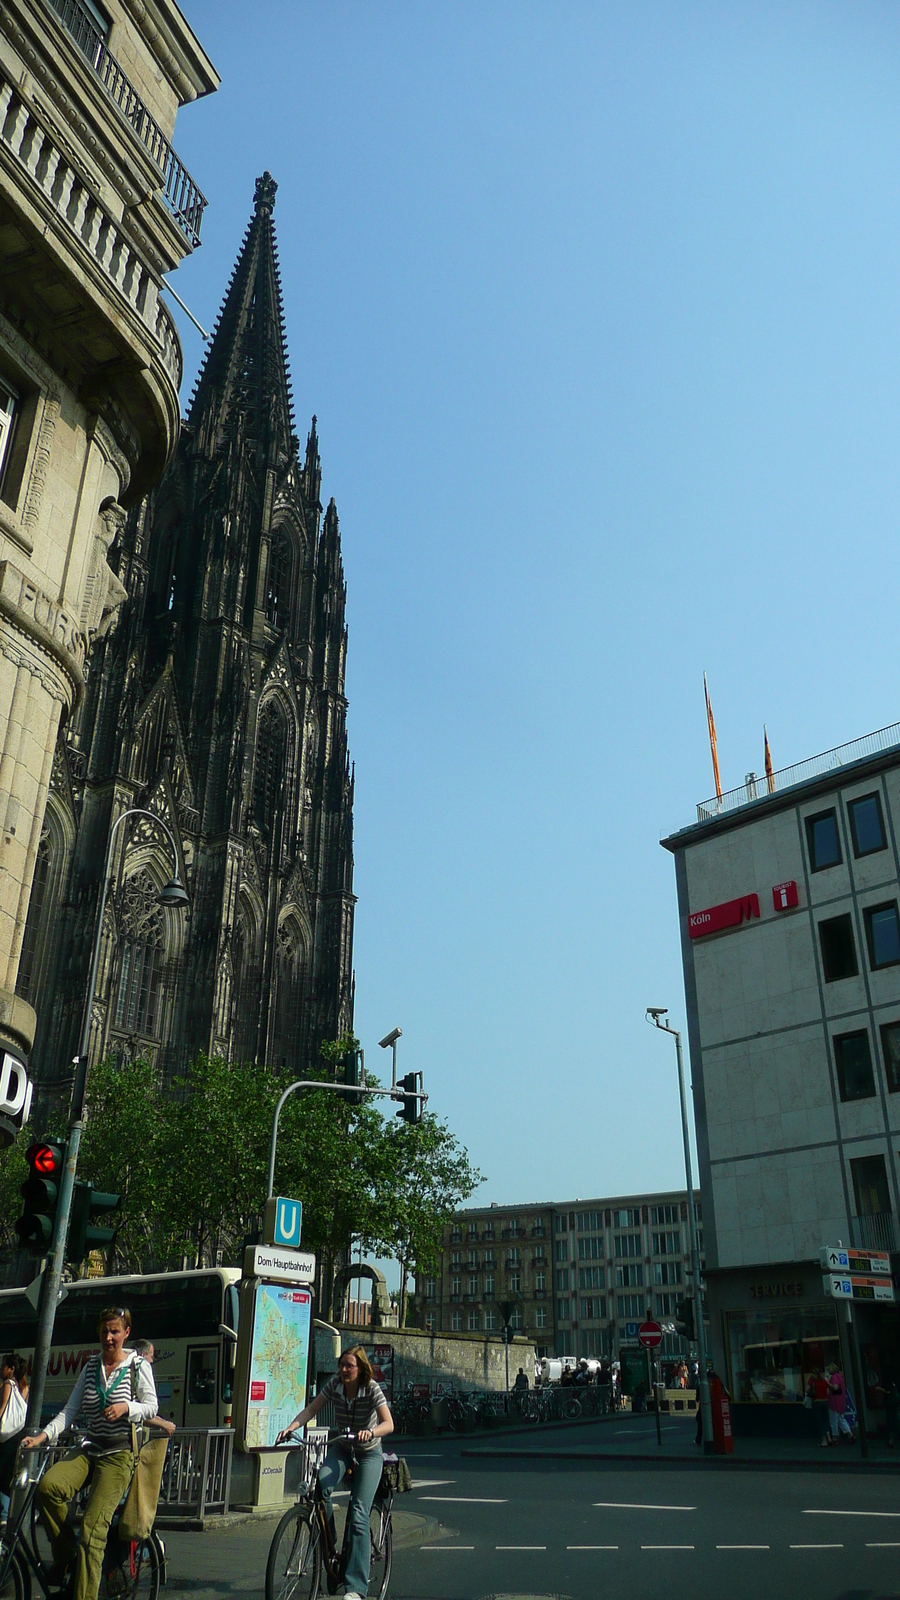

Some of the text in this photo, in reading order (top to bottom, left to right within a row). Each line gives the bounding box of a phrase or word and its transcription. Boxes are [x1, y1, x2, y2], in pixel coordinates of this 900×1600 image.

[773, 882, 792, 892] TOURIST
[690, 913, 711, 927] Köln
[279, 1203, 296, 1240] U
[257, 1255, 313, 1273] Dom/Hauptbahnhof
[749, 1282, 803, 1298] SERVICE
[627, 1324, 636, 1335] U
